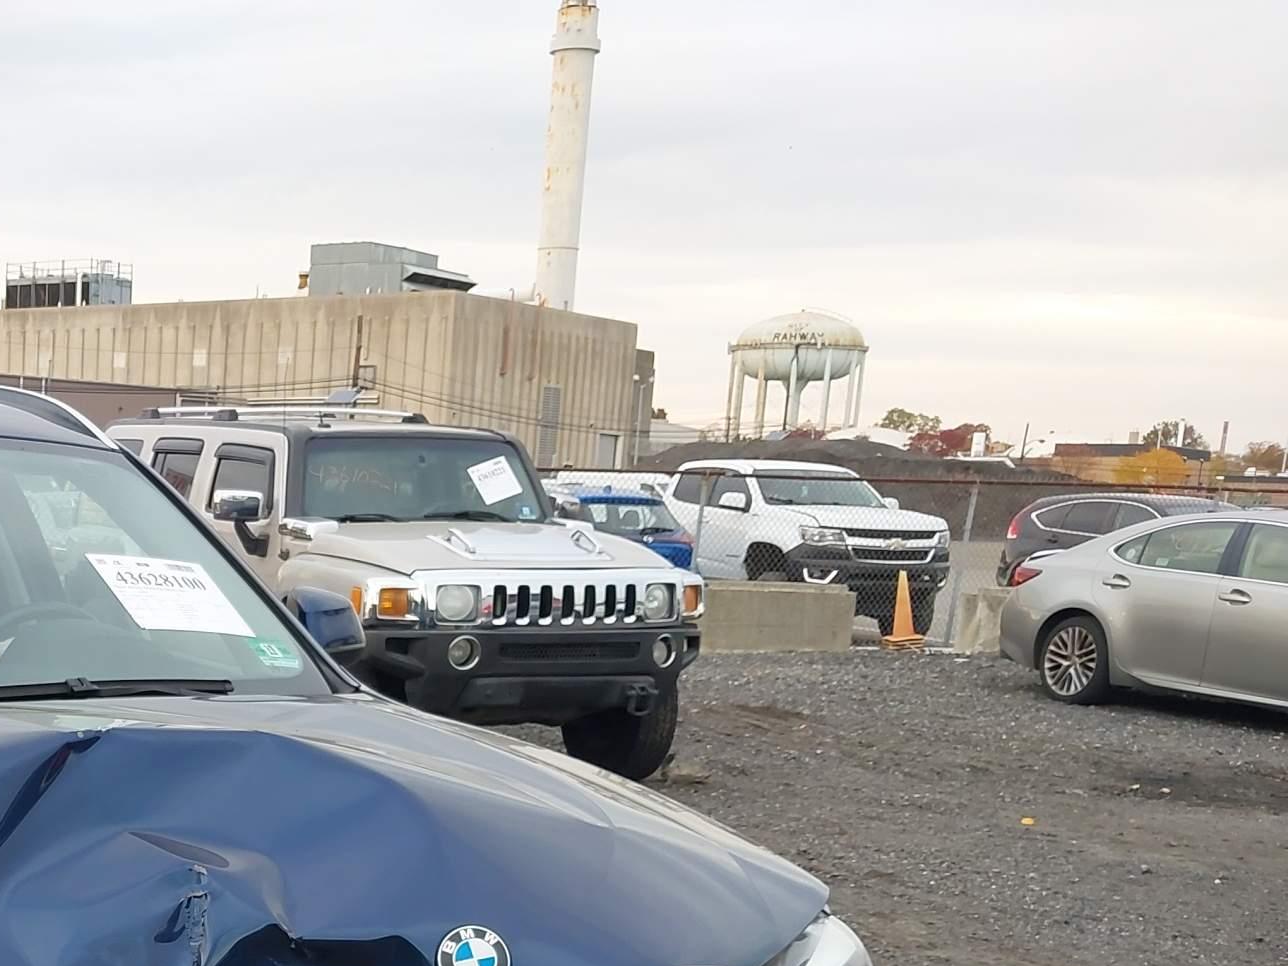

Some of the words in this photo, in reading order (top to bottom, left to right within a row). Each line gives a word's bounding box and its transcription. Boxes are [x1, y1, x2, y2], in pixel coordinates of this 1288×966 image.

[772, 332, 825, 342] RAHWAY
[115, 571, 207, 592] 43628100
[442, 928, 499, 955] BMW
